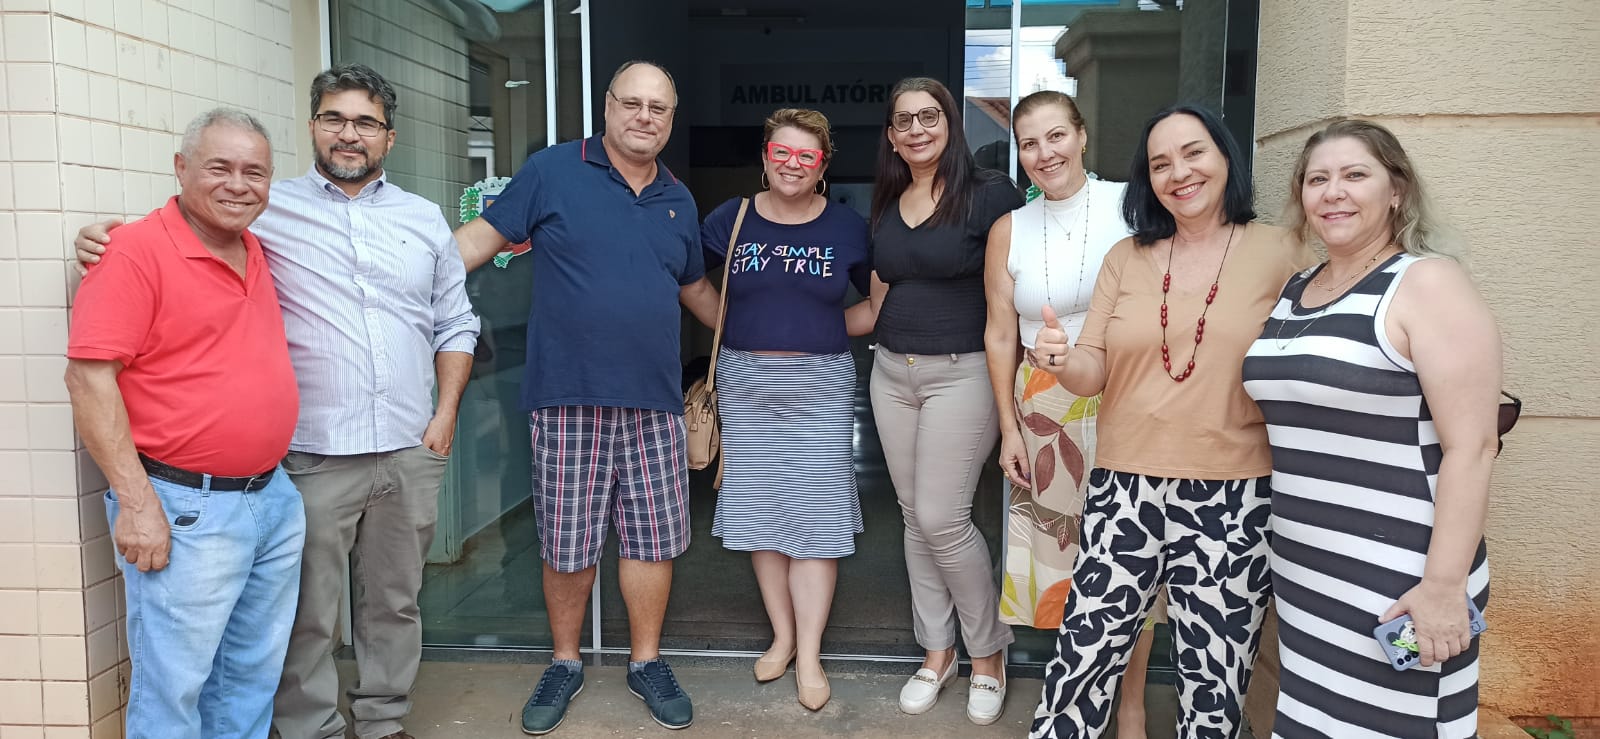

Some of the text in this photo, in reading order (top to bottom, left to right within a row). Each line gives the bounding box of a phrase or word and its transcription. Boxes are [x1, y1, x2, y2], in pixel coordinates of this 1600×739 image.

[731, 79, 894, 104] AMBULATÓRI
[734, 242, 835, 260] STAY SIMPLE
[731, 256, 833, 278] STAY TRUE
